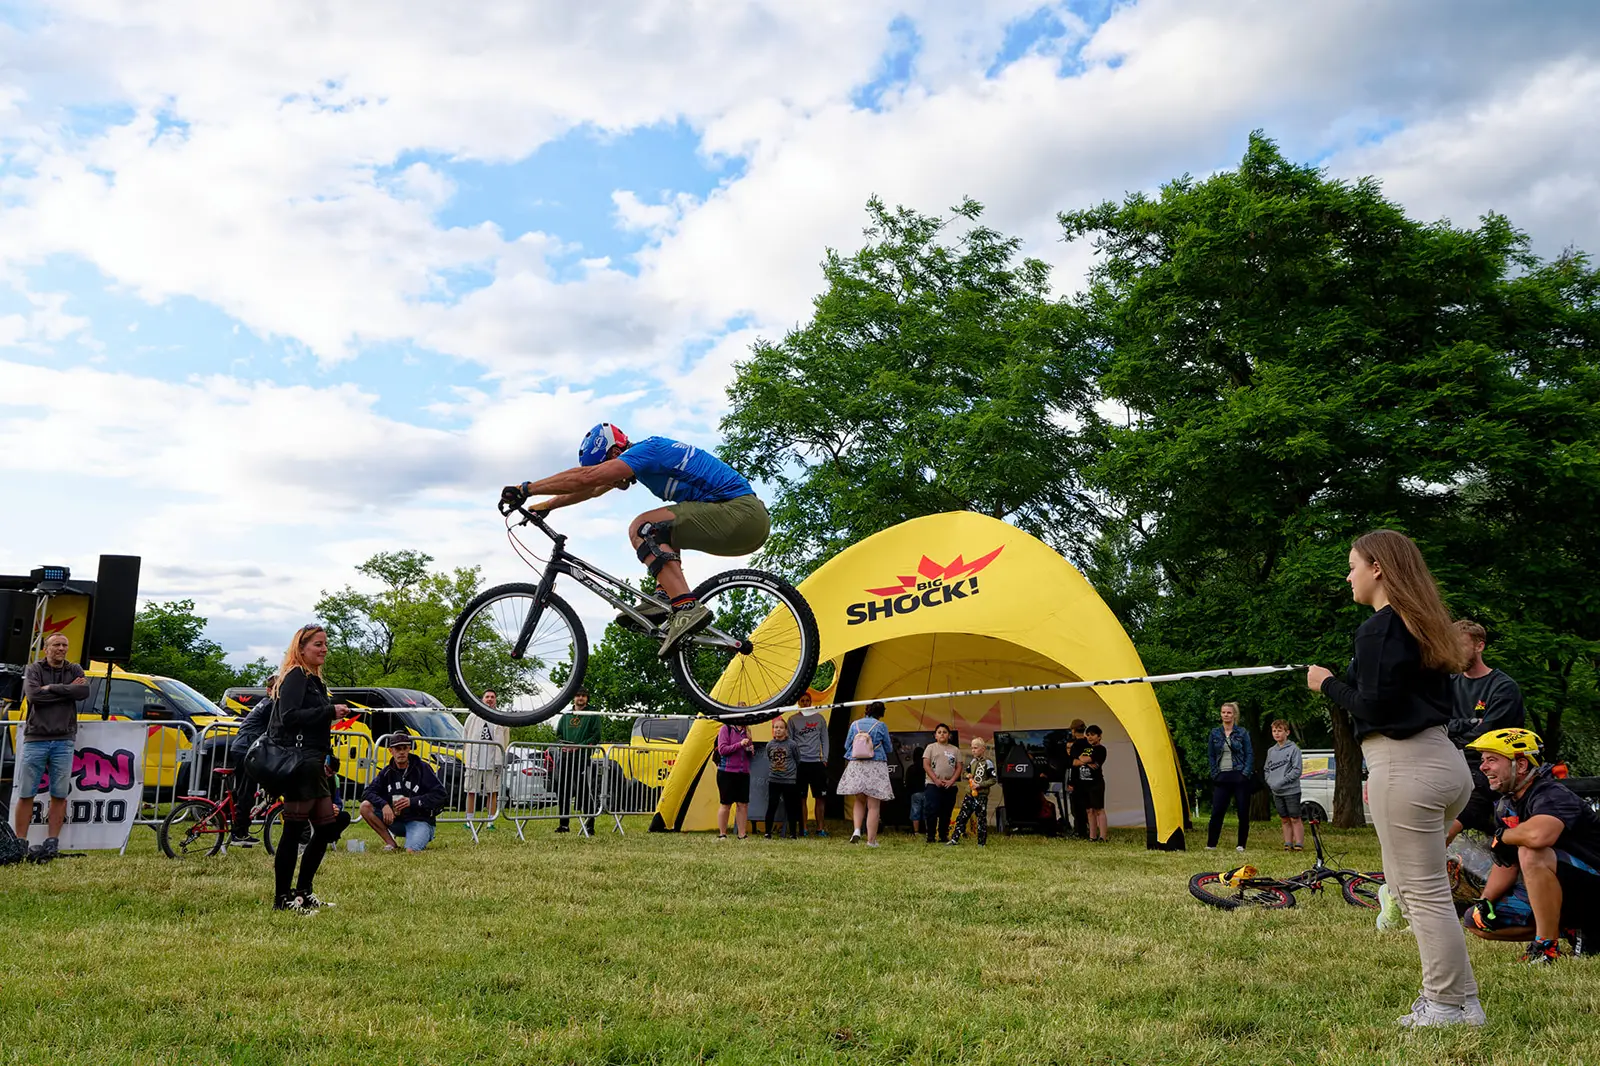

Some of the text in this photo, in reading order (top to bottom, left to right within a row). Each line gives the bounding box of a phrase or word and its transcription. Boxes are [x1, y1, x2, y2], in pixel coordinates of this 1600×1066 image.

[846, 576, 980, 625] SHOCK!
[917, 579, 942, 591] BIG
[38, 747, 135, 793] PIN
